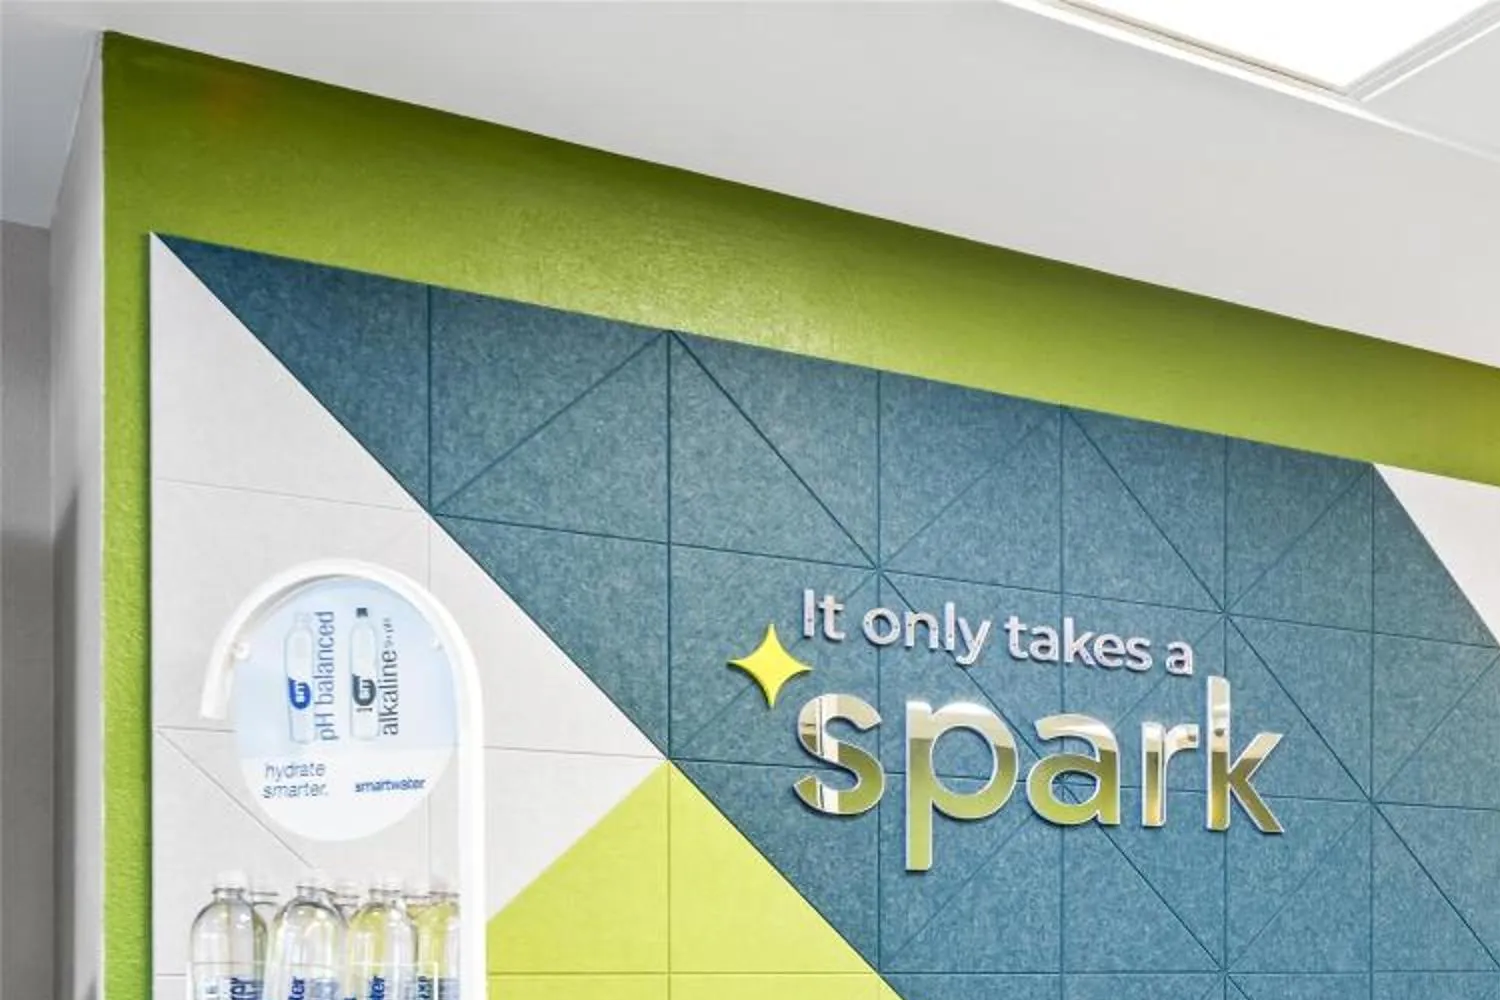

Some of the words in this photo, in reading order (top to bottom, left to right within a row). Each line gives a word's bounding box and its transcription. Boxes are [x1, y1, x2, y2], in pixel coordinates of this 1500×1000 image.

[313, 610, 336, 705] balanced
[802, 589, 846, 642] It
[861, 602, 992, 666] only
[1004, 614, 1154, 673] takes
[1165, 641, 1195, 676] a
[314, 712, 340, 741] pH
[378, 650, 400, 736] alkaline
[264, 760, 326, 780] hydrate
[354, 776, 427, 794] smartwater
[793, 675, 1285, 872] spark
